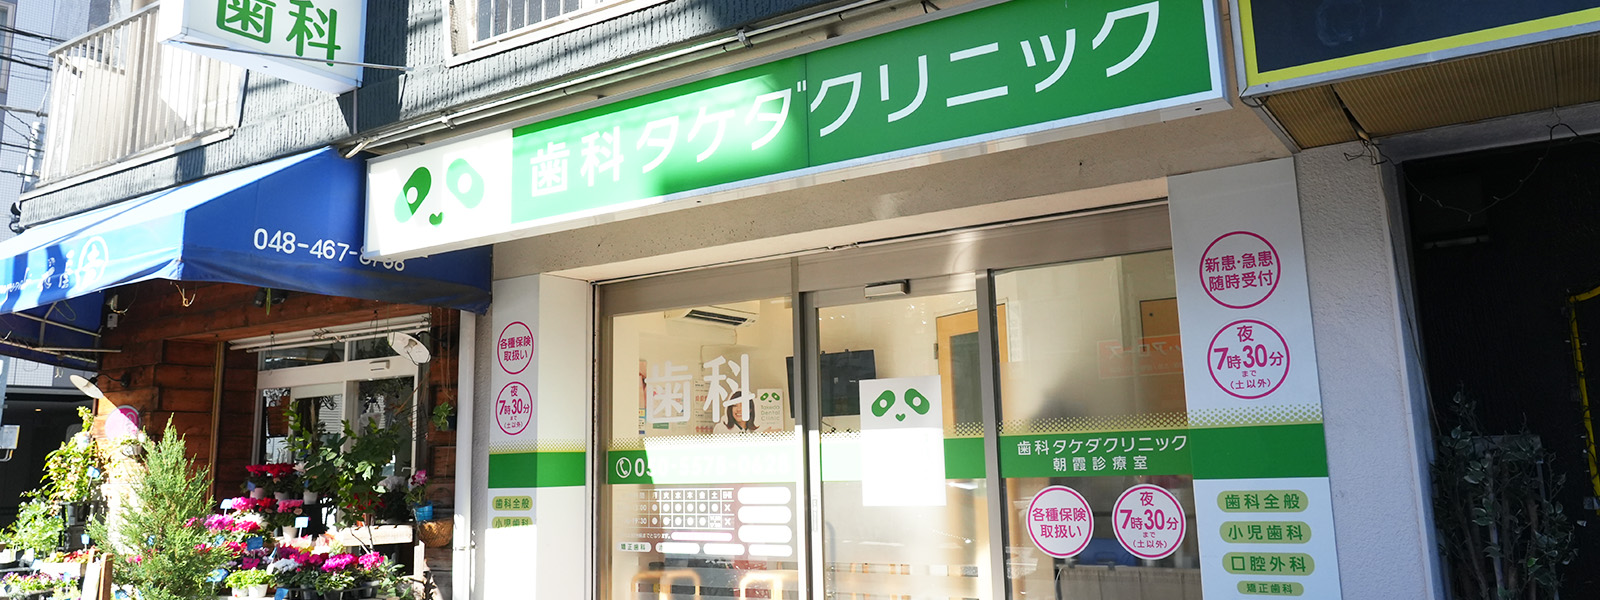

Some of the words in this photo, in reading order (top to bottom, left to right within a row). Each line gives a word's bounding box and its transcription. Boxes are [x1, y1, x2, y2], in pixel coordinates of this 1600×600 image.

[216, 0, 342, 66] 歯科
[529, 0, 1161, 197] 歯科タケダクリニック
[1209, 270, 1274, 292] 随時受付
[1237, 325, 1254, 342] 夜
[500, 335, 532, 350] 各種保険
[503, 350, 528, 361] 取扱い
[1213, 344, 1285, 370] 7時30分
[510, 385, 518, 397] 夜
[644, 353, 756, 423] 歯科
[499, 398, 530, 415] 7時30分
[1017, 435, 1187, 455] 歯科タケダクリニック
[1053, 455, 1148, 472] 朝霞診療室
[495, 498, 530, 509] 歯科全般
[1139, 491, 1154, 507] 夜
[1225, 493, 1300, 509] 歯科全般
[1032, 507, 1087, 522] 各種保険
[1120, 509, 1179, 530] 7時30分
[1040, 525, 1082, 539] 取扱い
[1228, 524, 1303, 540] 小児歯科
[1231, 555, 1306, 572] 口腔外科
[1246, 583, 1293, 594] 矯正歯科
